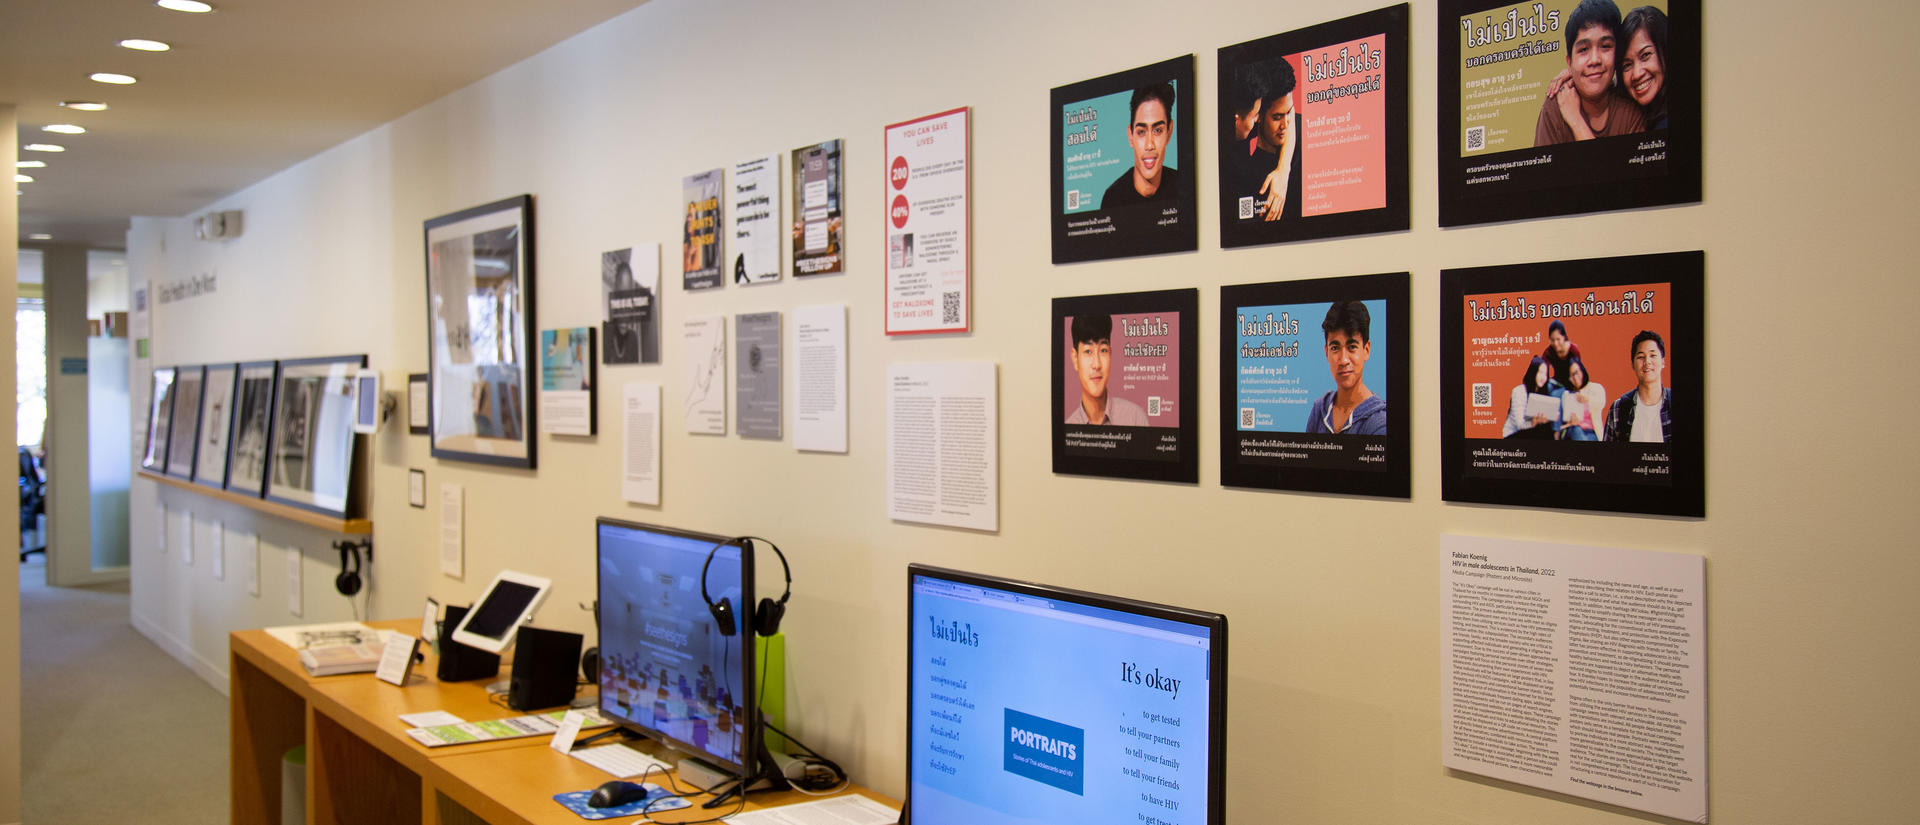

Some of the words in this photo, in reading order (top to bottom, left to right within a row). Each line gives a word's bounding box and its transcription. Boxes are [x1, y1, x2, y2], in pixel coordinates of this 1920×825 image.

[1462, 2, 1560, 48] ไม่เป็นไร
[1304, 43, 1382, 83] ไม่เป็นไร
[1065, 106, 1098, 125] ไม่เป็นไร
[917, 126, 930, 135] CAN
[932, 121, 948, 132] SAVE
[916, 137, 934, 147] LIVES
[892, 166, 907, 181] 200
[1469, 298, 1536, 322] ไม่เป็นไร
[1540, 290, 1655, 318] บอกเพื่อนก็ได้
[1121, 317, 1169, 337] ไม่เป็นไร
[1238, 312, 1299, 336] ไม่เป็นไร
[1509, 335, 1523, 346] อายุ
[1534, 332, 1541, 343] ปี
[1452, 551, 1468, 559] Fabian
[1469, 553, 1488, 561] Koenig
[1480, 563, 1509, 572] adolescents
[1516, 566, 1539, 575] Thailand,
[1540, 569, 1556, 577] 2022
[929, 615, 979, 648] ไม่เป็นไร
[1145, 668, 1181, 700] okay
[1142, 710, 1150, 719] to
[1150, 713, 1161, 723] get
[1161, 715, 1181, 728] tested
[1010, 726, 1077, 761] PORTRAITS
[1119, 725, 1126, 734] to
[1127, 726, 1137, 737] tell
[1137, 731, 1152, 742] your
[1153, 734, 1181, 749] partners
[1125, 746, 1132, 755] to
[1133, 748, 1143, 759] tell
[1143, 753, 1158, 764] your
[1159, 753, 1180, 772] family
[1122, 766, 1130, 775] to
[1130, 768, 1140, 779] tell
[1141, 773, 1156, 784] your
[1157, 775, 1180, 791] friends
[1141, 792, 1148, 801] to
[1149, 793, 1164, 807] have
[1165, 798, 1179, 811] HIV
[1138, 812, 1145, 821] to
